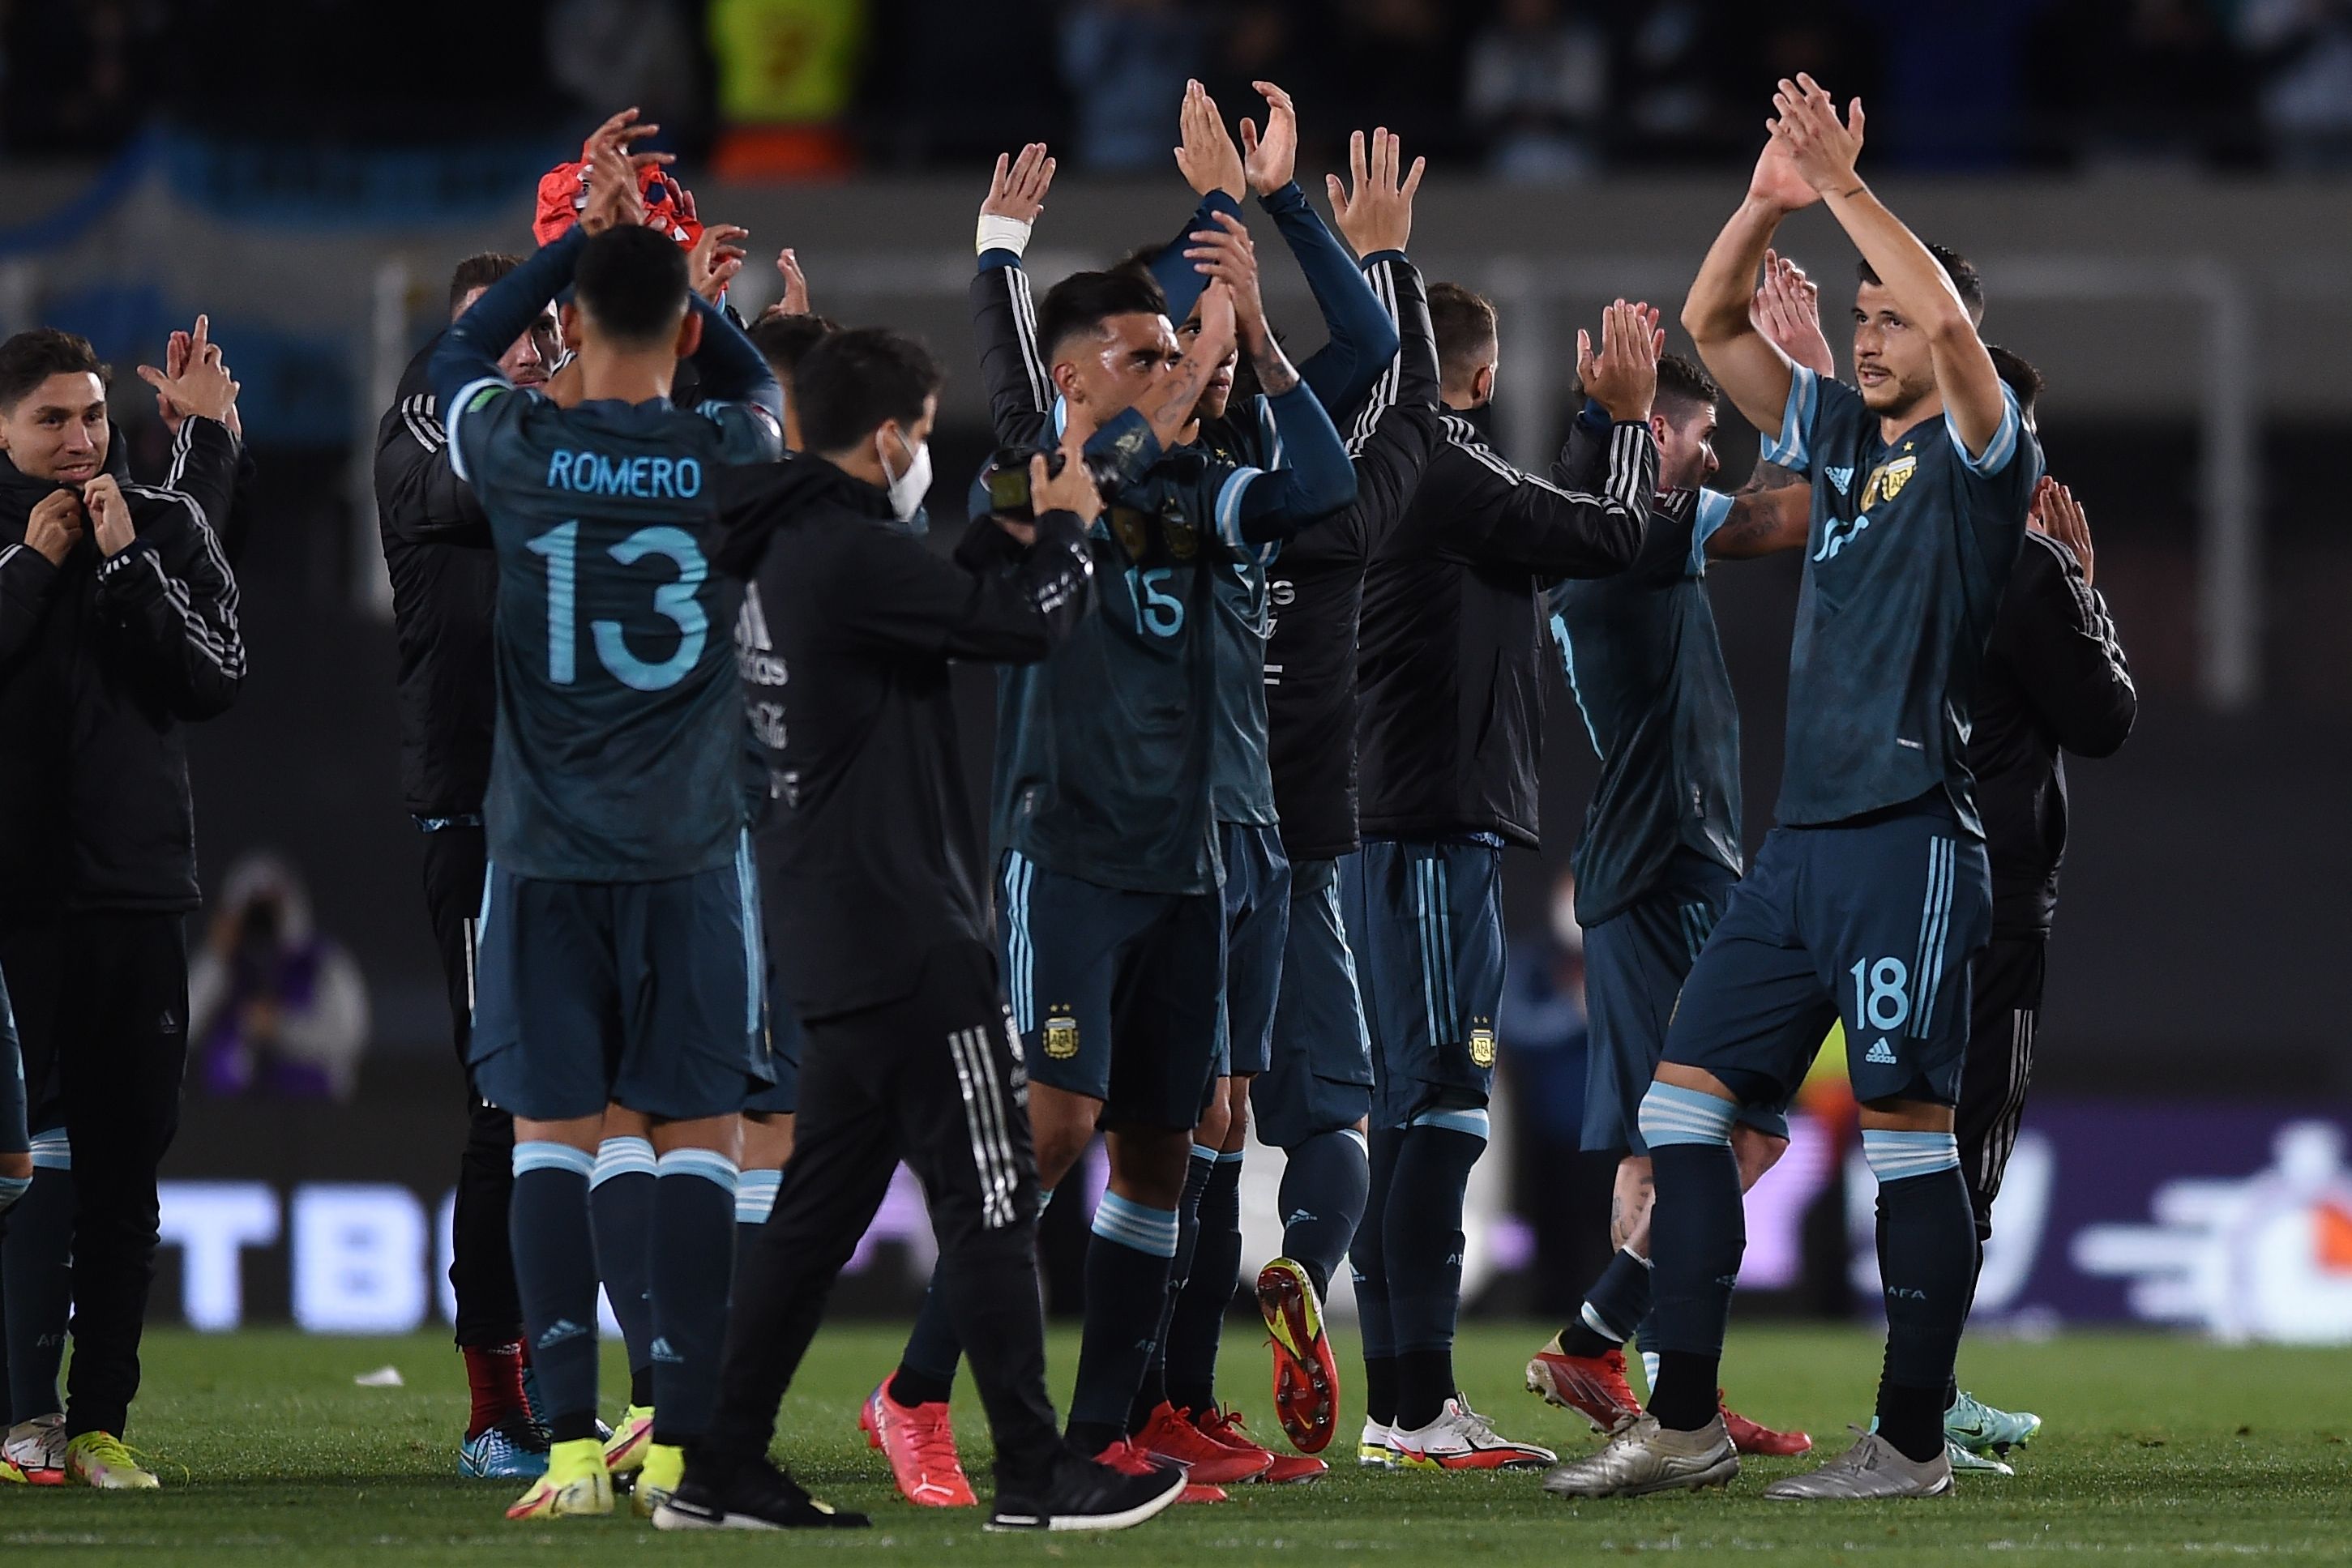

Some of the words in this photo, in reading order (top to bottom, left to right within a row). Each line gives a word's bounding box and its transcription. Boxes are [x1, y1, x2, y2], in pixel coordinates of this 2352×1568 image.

[548, 448, 702, 498] ROMERO
[525, 519, 709, 691] 13
[1124, 566, 1183, 637] 15
[1850, 957, 1909, 1030] 18
[1475, 1040, 1490, 1057] AFA
[1865, 1053, 1897, 1064] adidas
[1888, 1286, 1926, 1299] AFA
